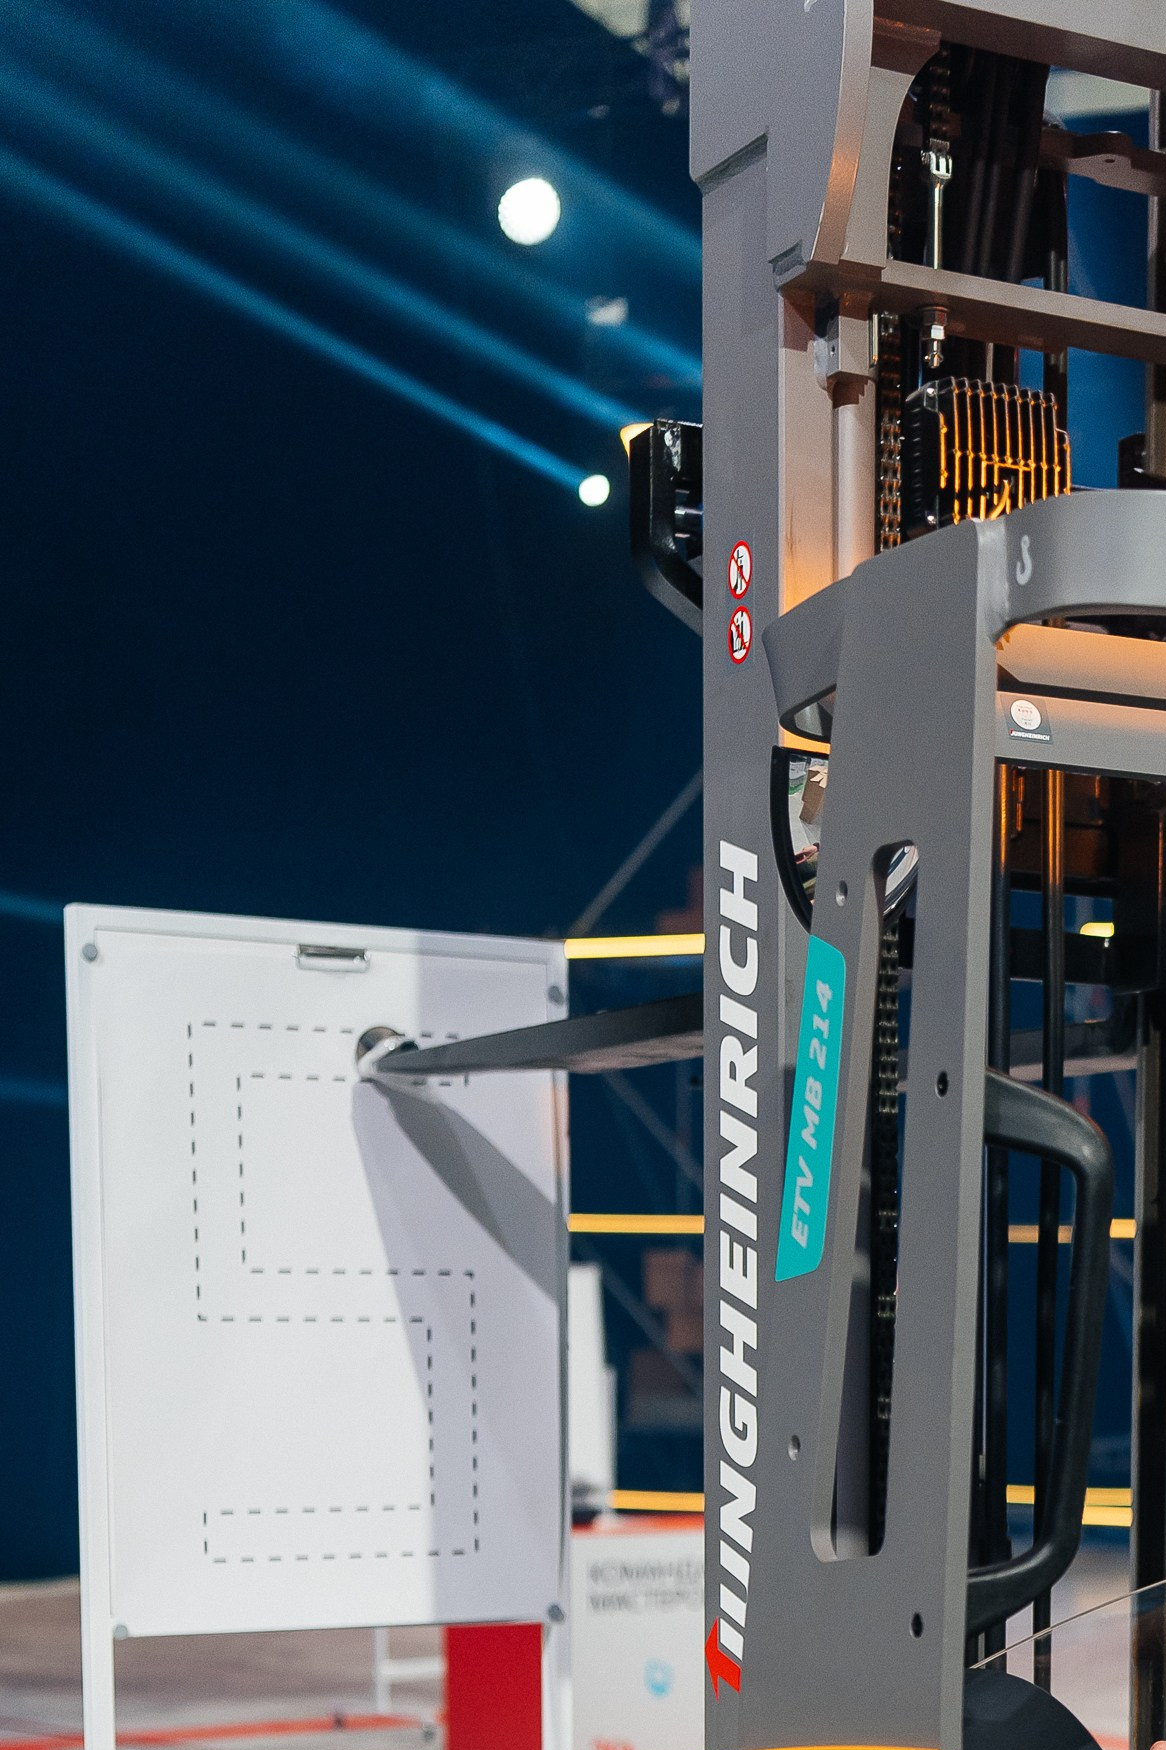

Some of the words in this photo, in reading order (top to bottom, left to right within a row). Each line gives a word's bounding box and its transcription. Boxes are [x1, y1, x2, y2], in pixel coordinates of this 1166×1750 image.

[809, 979, 834, 1071] 214
[801, 1075, 823, 1151] MB
[791, 1155, 814, 1249] ETV
[719, 839, 758, 1664] JUNGHEINRICH
